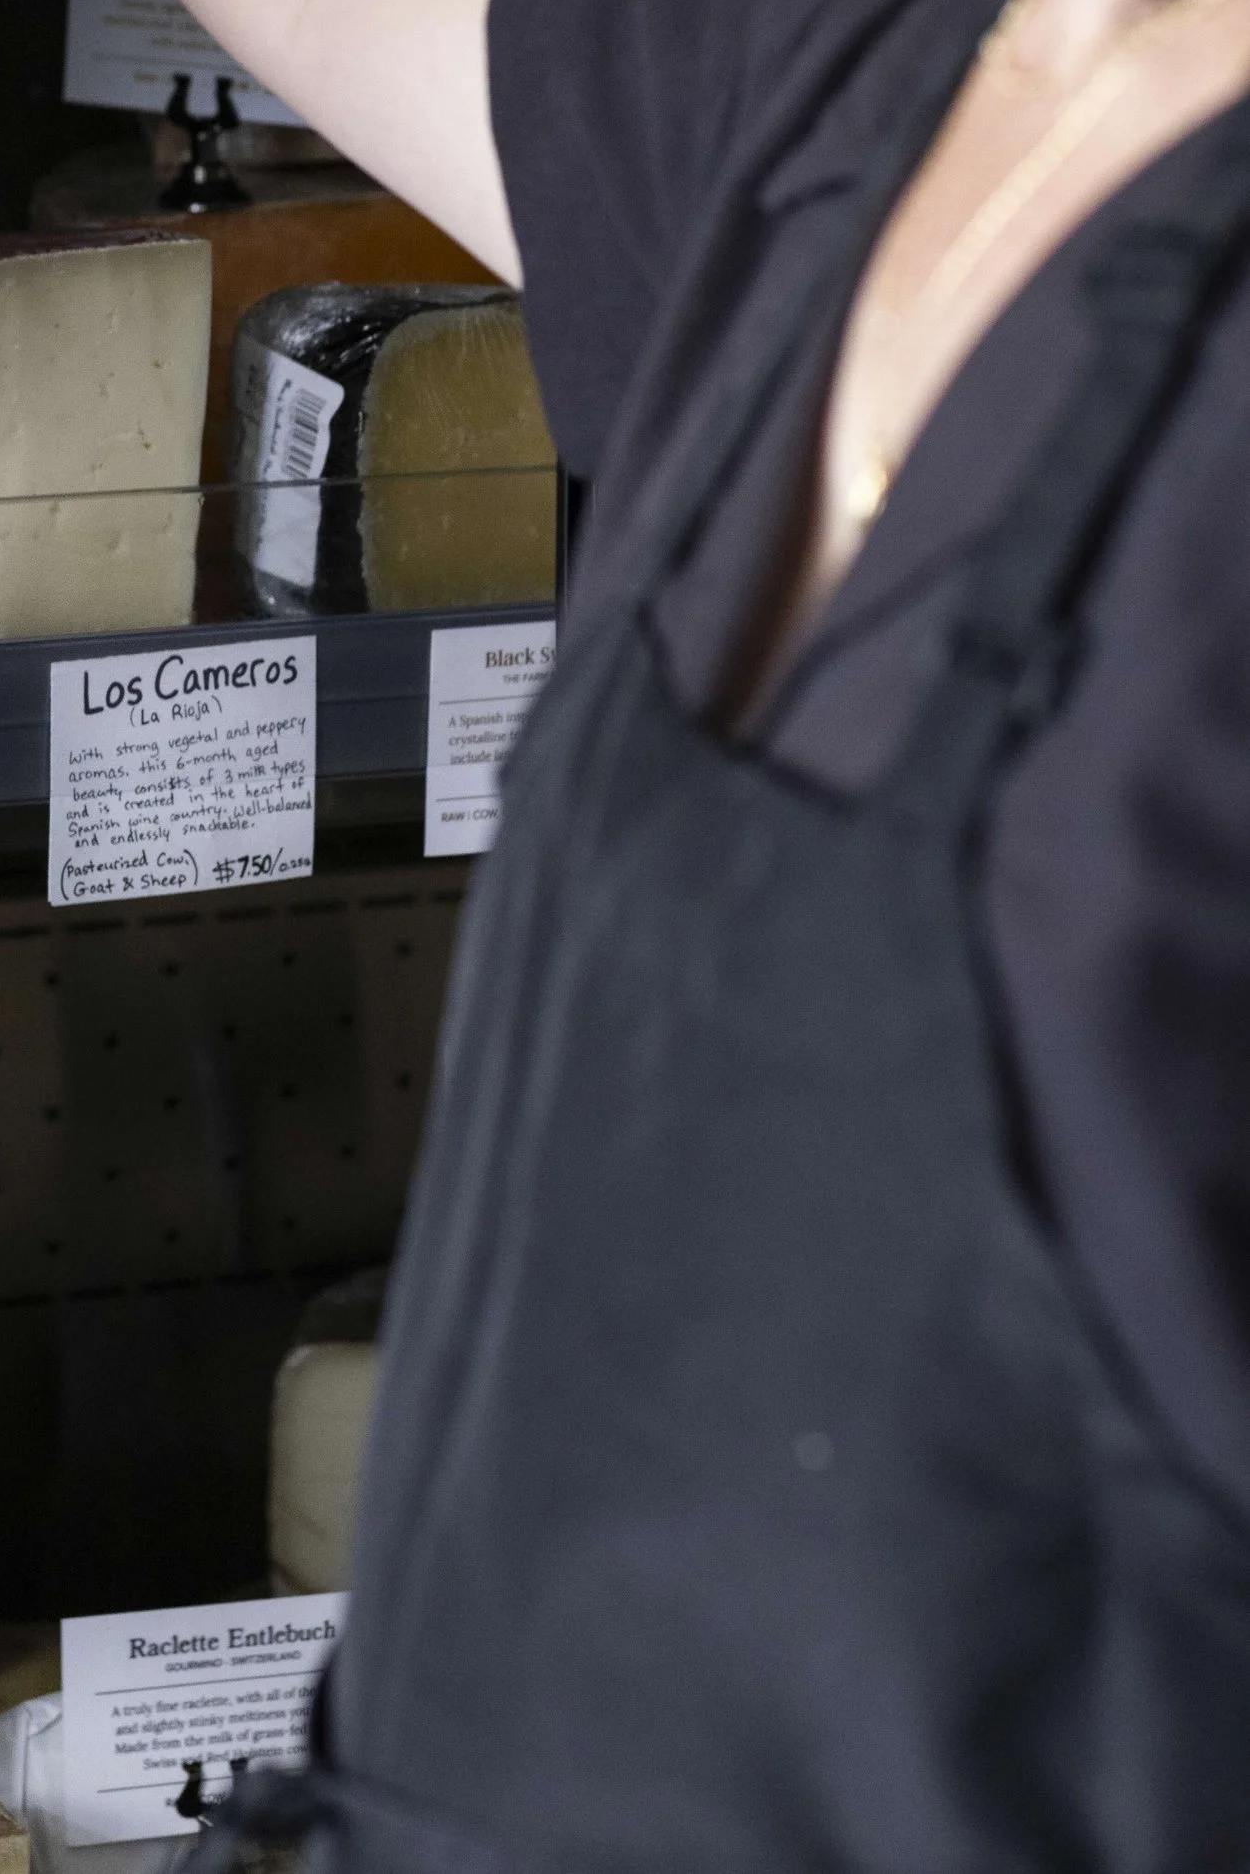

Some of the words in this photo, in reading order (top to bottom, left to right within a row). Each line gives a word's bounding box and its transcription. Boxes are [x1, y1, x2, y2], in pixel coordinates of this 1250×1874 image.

[485, 649, 535, 669] Black
[84, 672, 143, 715] Los
[154, 656, 298, 700] Cameros
[130, 1635, 219, 1658] Raclette
[228, 1620, 335, 1648] Entlebuch
